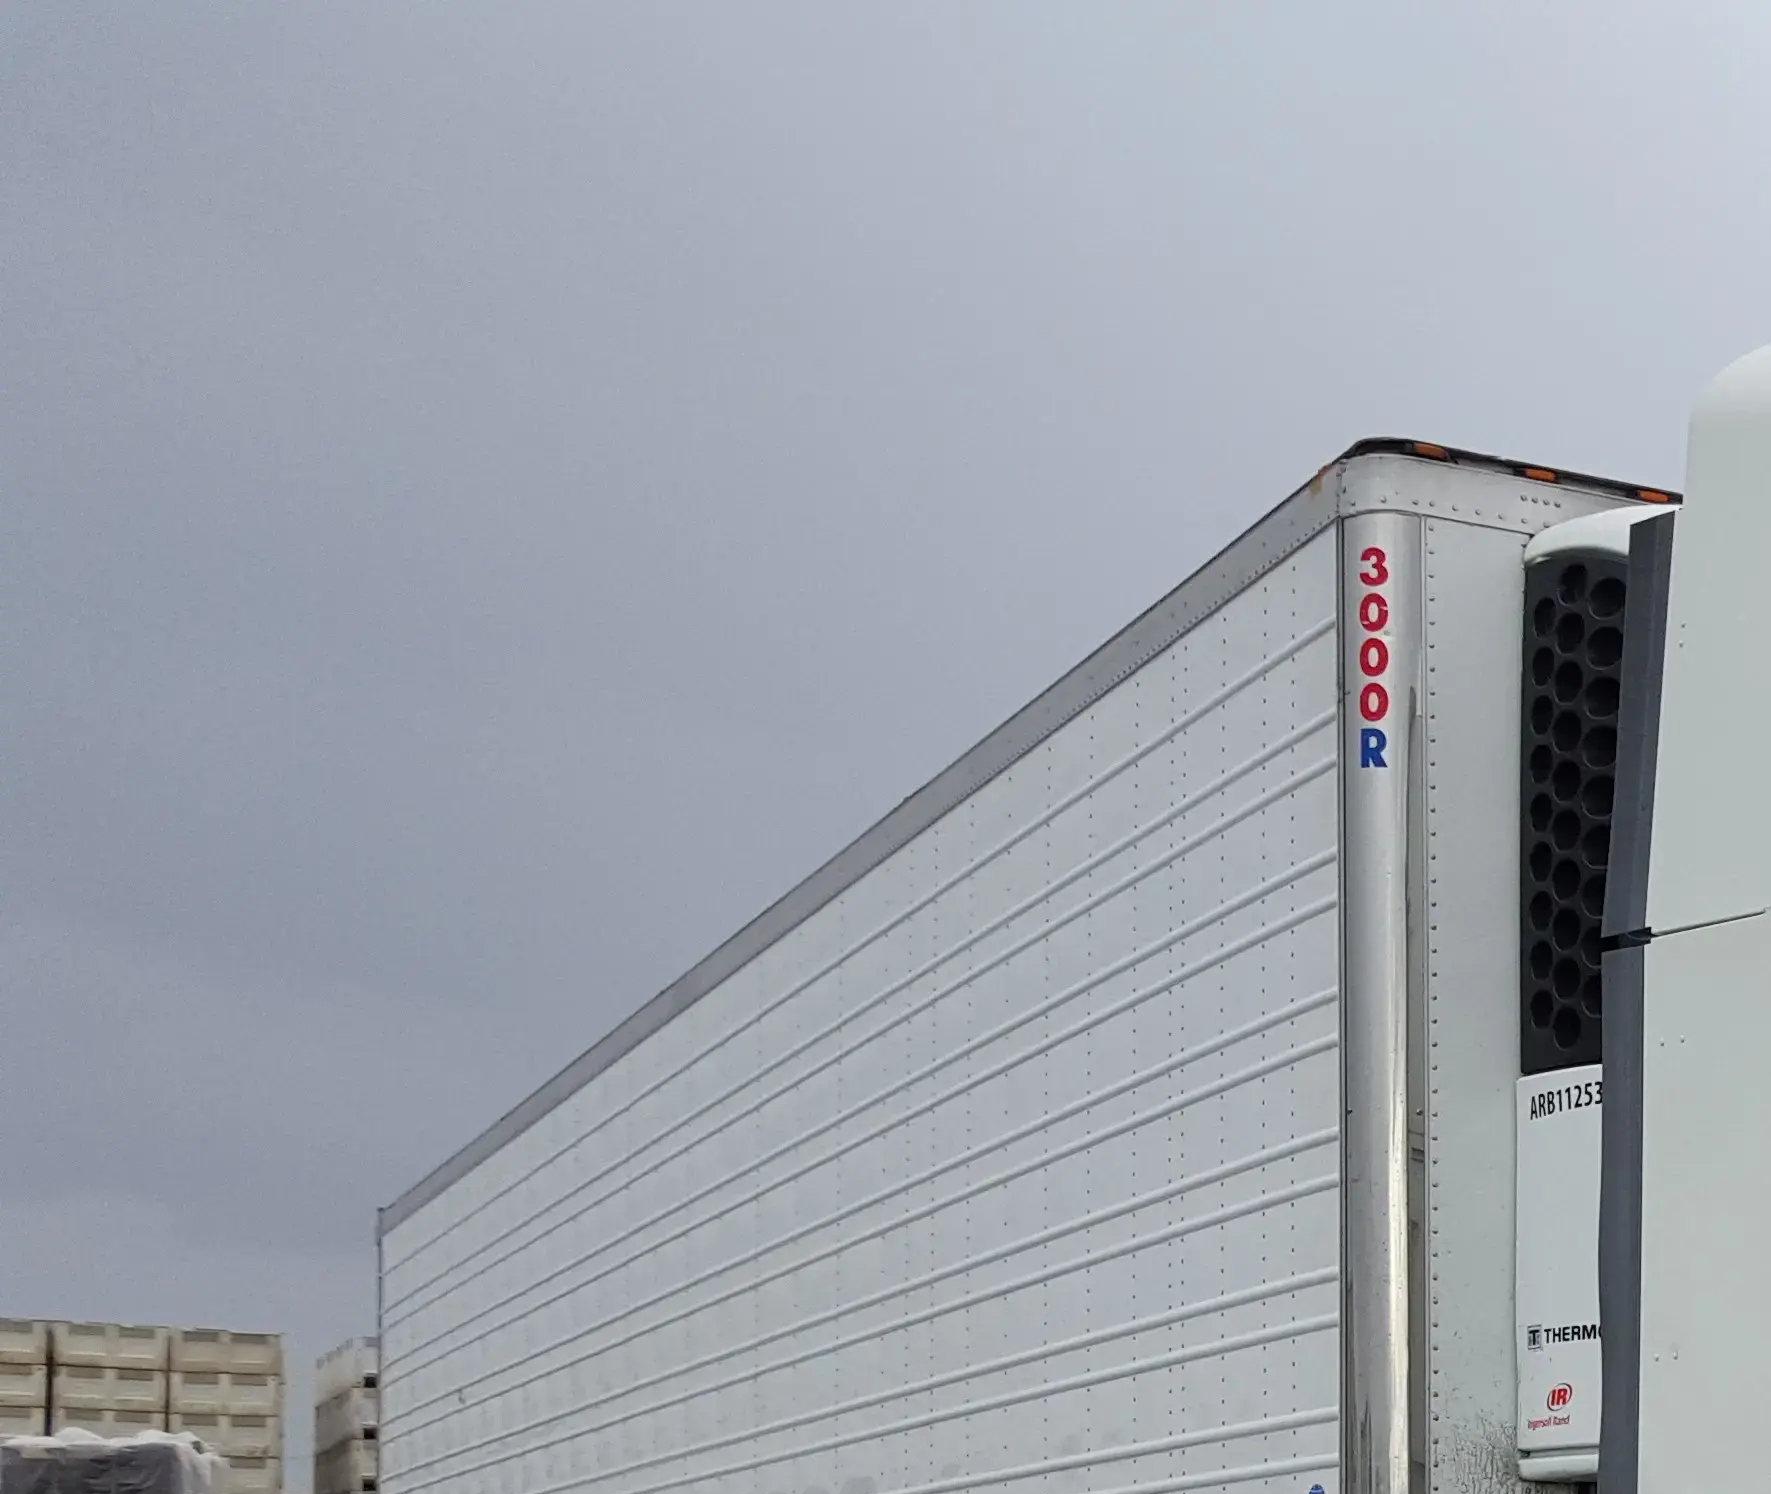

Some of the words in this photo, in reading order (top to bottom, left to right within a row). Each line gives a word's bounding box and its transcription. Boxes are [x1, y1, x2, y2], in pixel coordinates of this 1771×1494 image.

[1359, 547, 1389, 769] 3000R
[1544, 1324, 1602, 1344] THERM
[1551, 1388, 1568, 1407] IR
